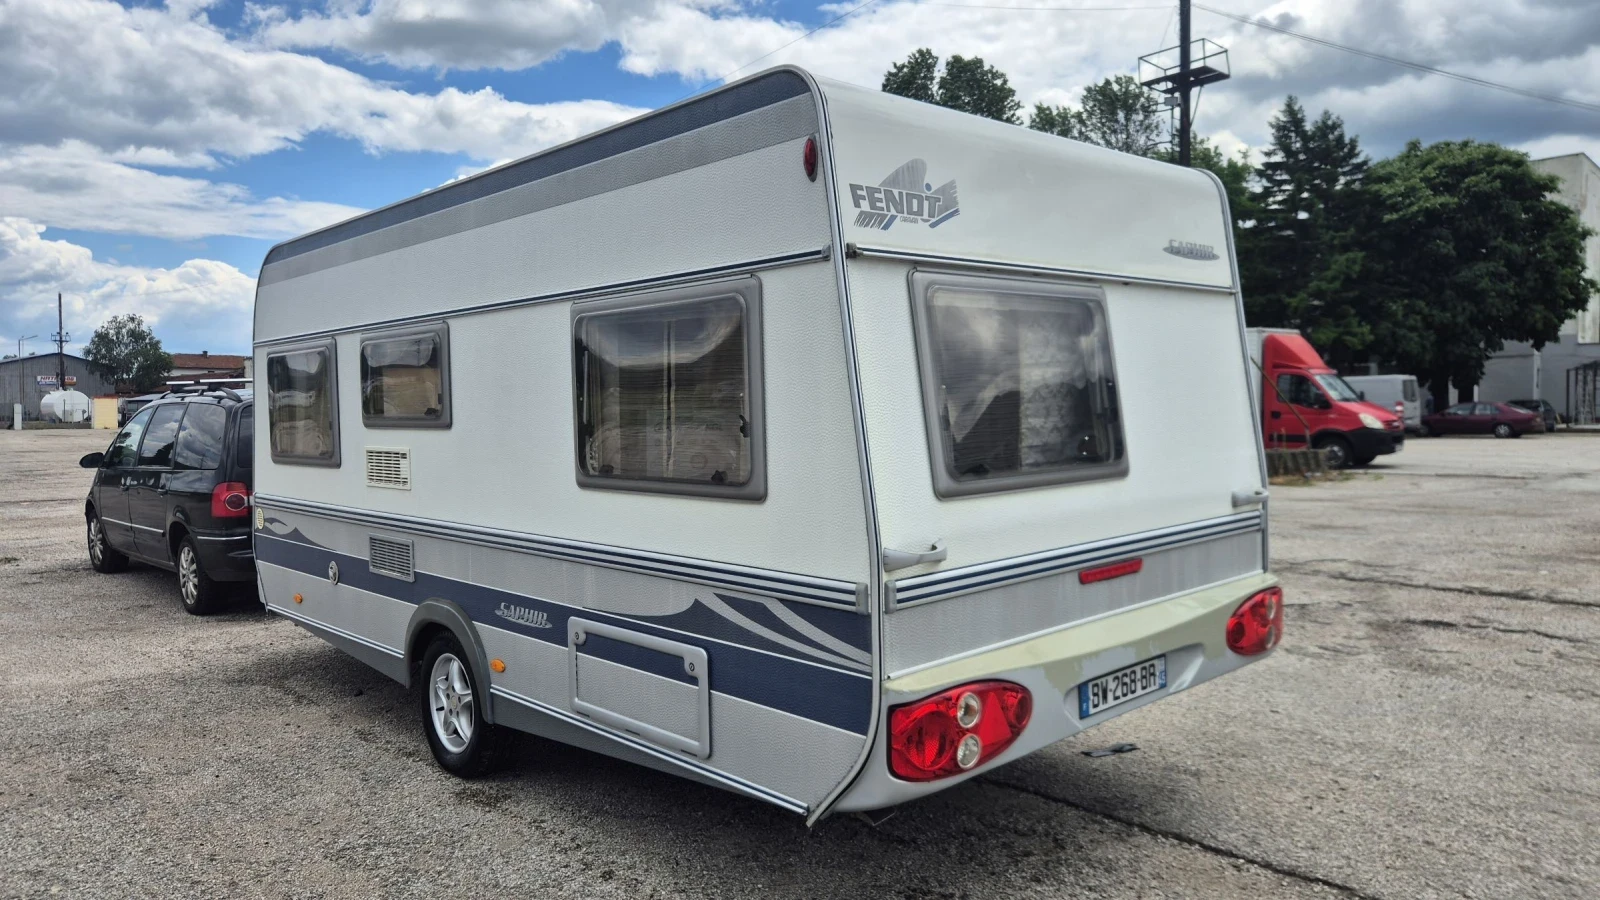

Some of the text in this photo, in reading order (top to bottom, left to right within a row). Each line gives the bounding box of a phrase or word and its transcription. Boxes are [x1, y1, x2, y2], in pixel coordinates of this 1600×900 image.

[849, 183, 941, 219] FENDT
[500, 602, 549, 627] SAPHIR
[1091, 663, 1156, 709] BW-268-BR
